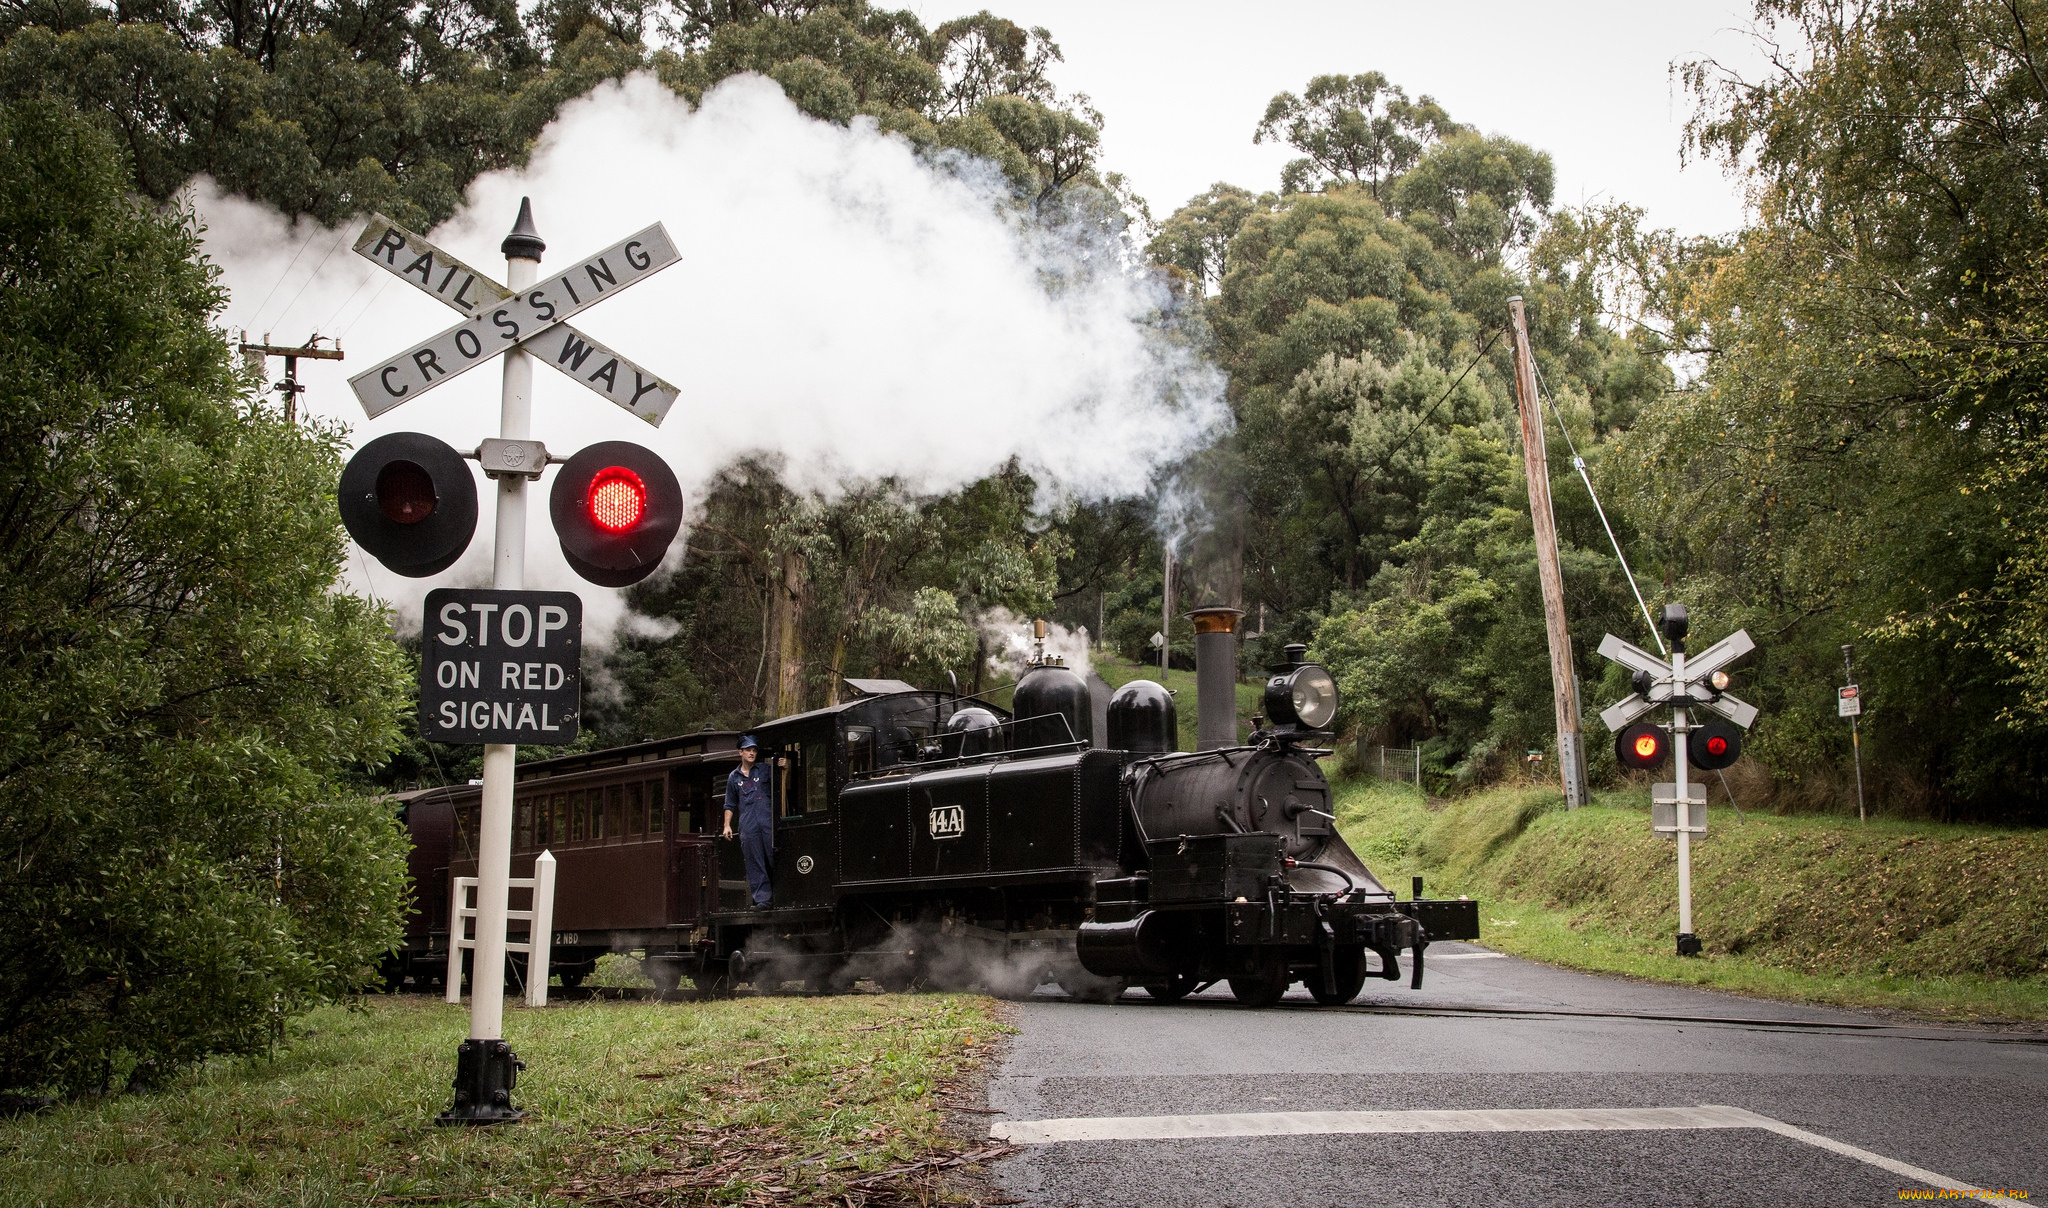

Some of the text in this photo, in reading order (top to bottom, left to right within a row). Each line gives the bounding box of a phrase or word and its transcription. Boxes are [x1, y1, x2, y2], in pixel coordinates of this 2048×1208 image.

[372, 227, 658, 407] RAIL WAY
[380, 241, 651, 398] CROSSING
[437, 602, 569, 648] STOP
[437, 660, 565, 691] ON RED
[438, 700, 560, 731] SIGNAL
[930, 808, 961, 834] 14A
[556, 933, 561, 945] 2
